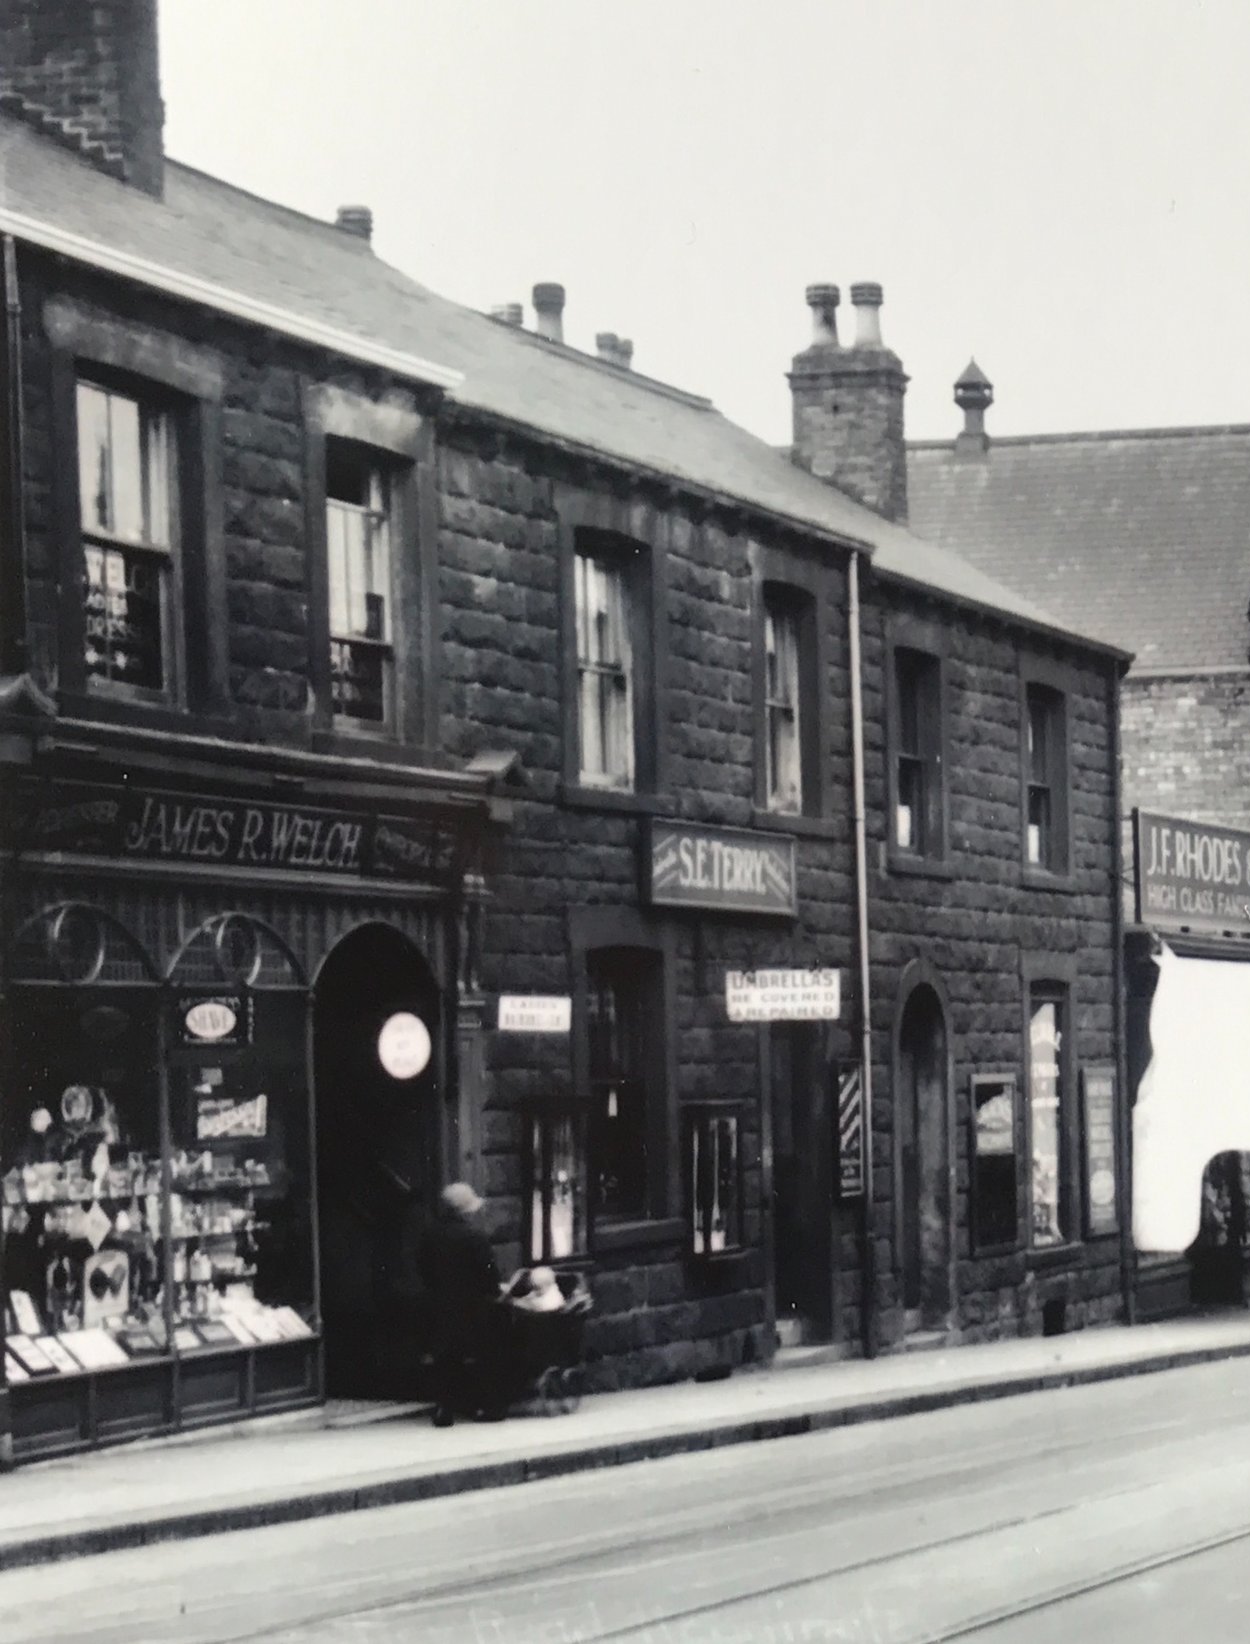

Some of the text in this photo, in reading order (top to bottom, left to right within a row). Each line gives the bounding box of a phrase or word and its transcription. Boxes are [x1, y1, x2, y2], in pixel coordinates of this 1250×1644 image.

[126, 798, 234, 857] JAMES
[1147, 884, 1177, 911] HIGH
[1180, 886, 1214, 913] CLASS
